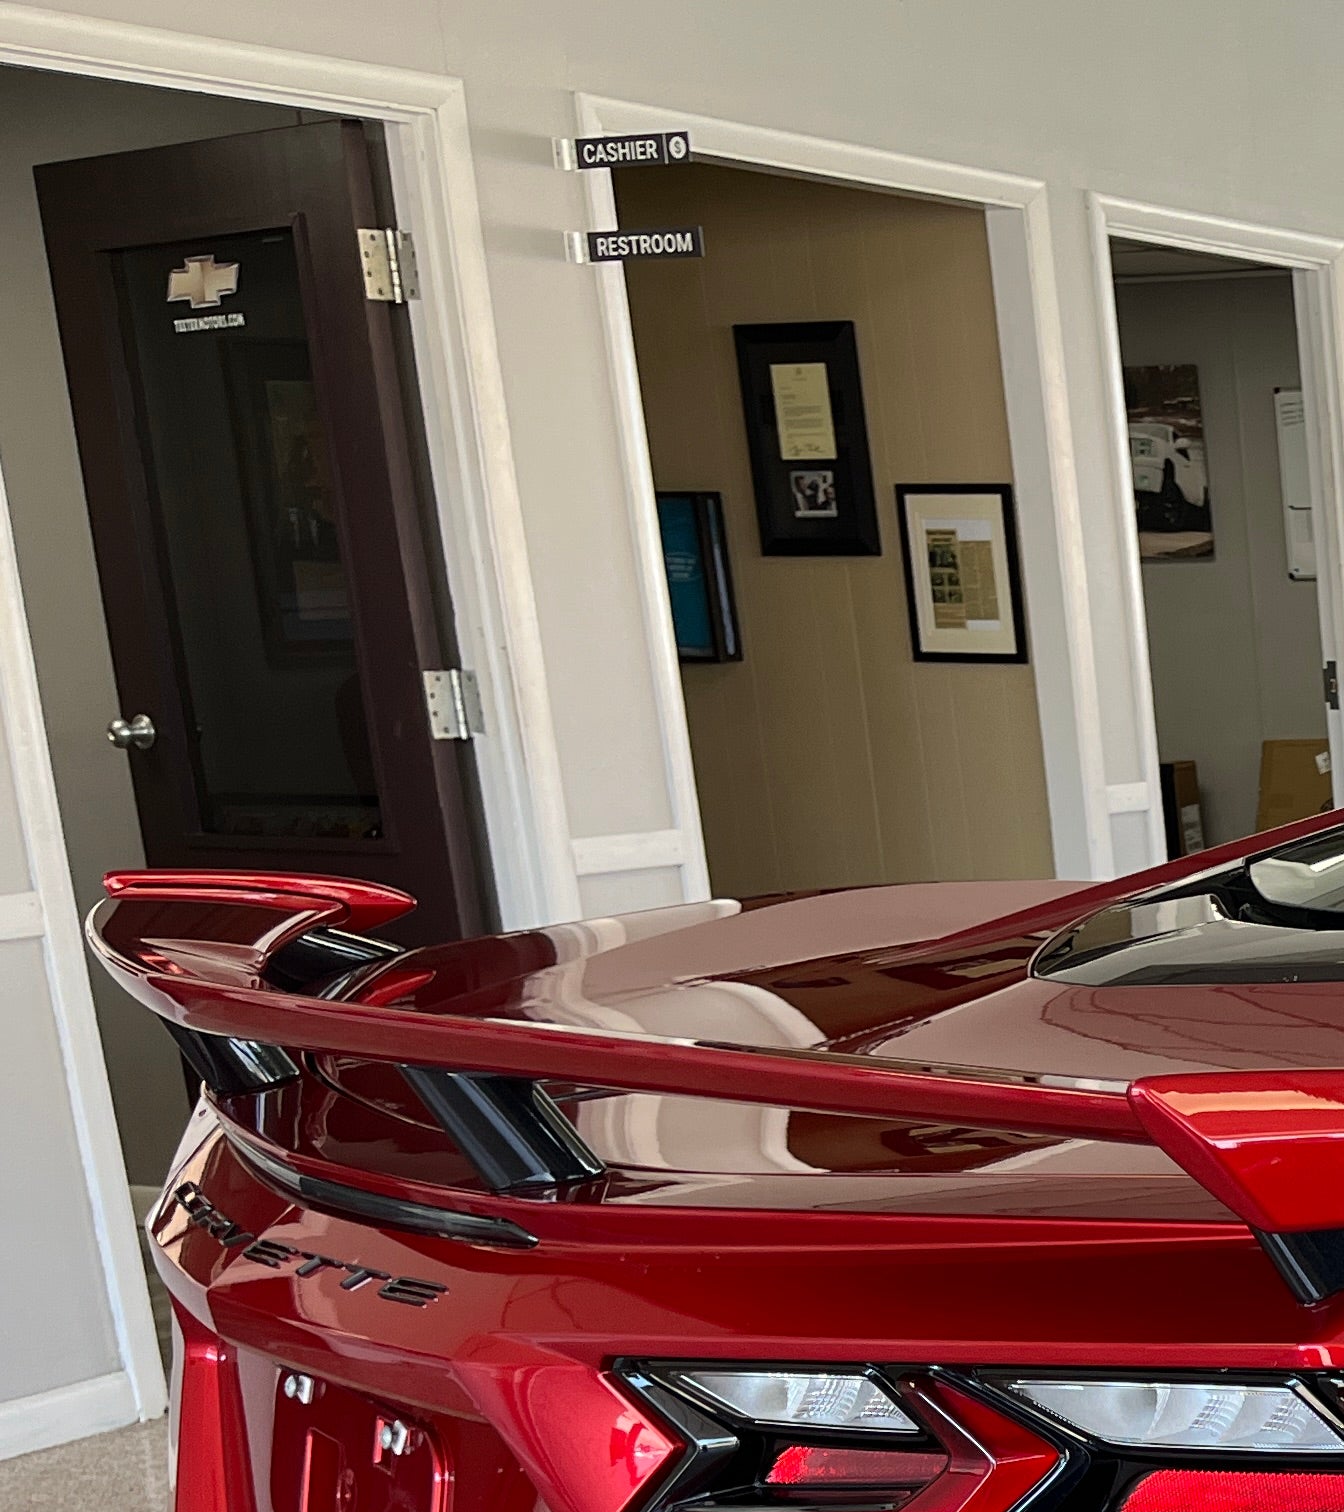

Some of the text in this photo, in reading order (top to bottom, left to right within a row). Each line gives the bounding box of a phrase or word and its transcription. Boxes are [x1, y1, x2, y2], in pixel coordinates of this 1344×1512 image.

[583, 140, 658, 163] CASHIER
[596, 233, 693, 256] RESTROOM
[174, 1181, 449, 1307] ORVETTE
